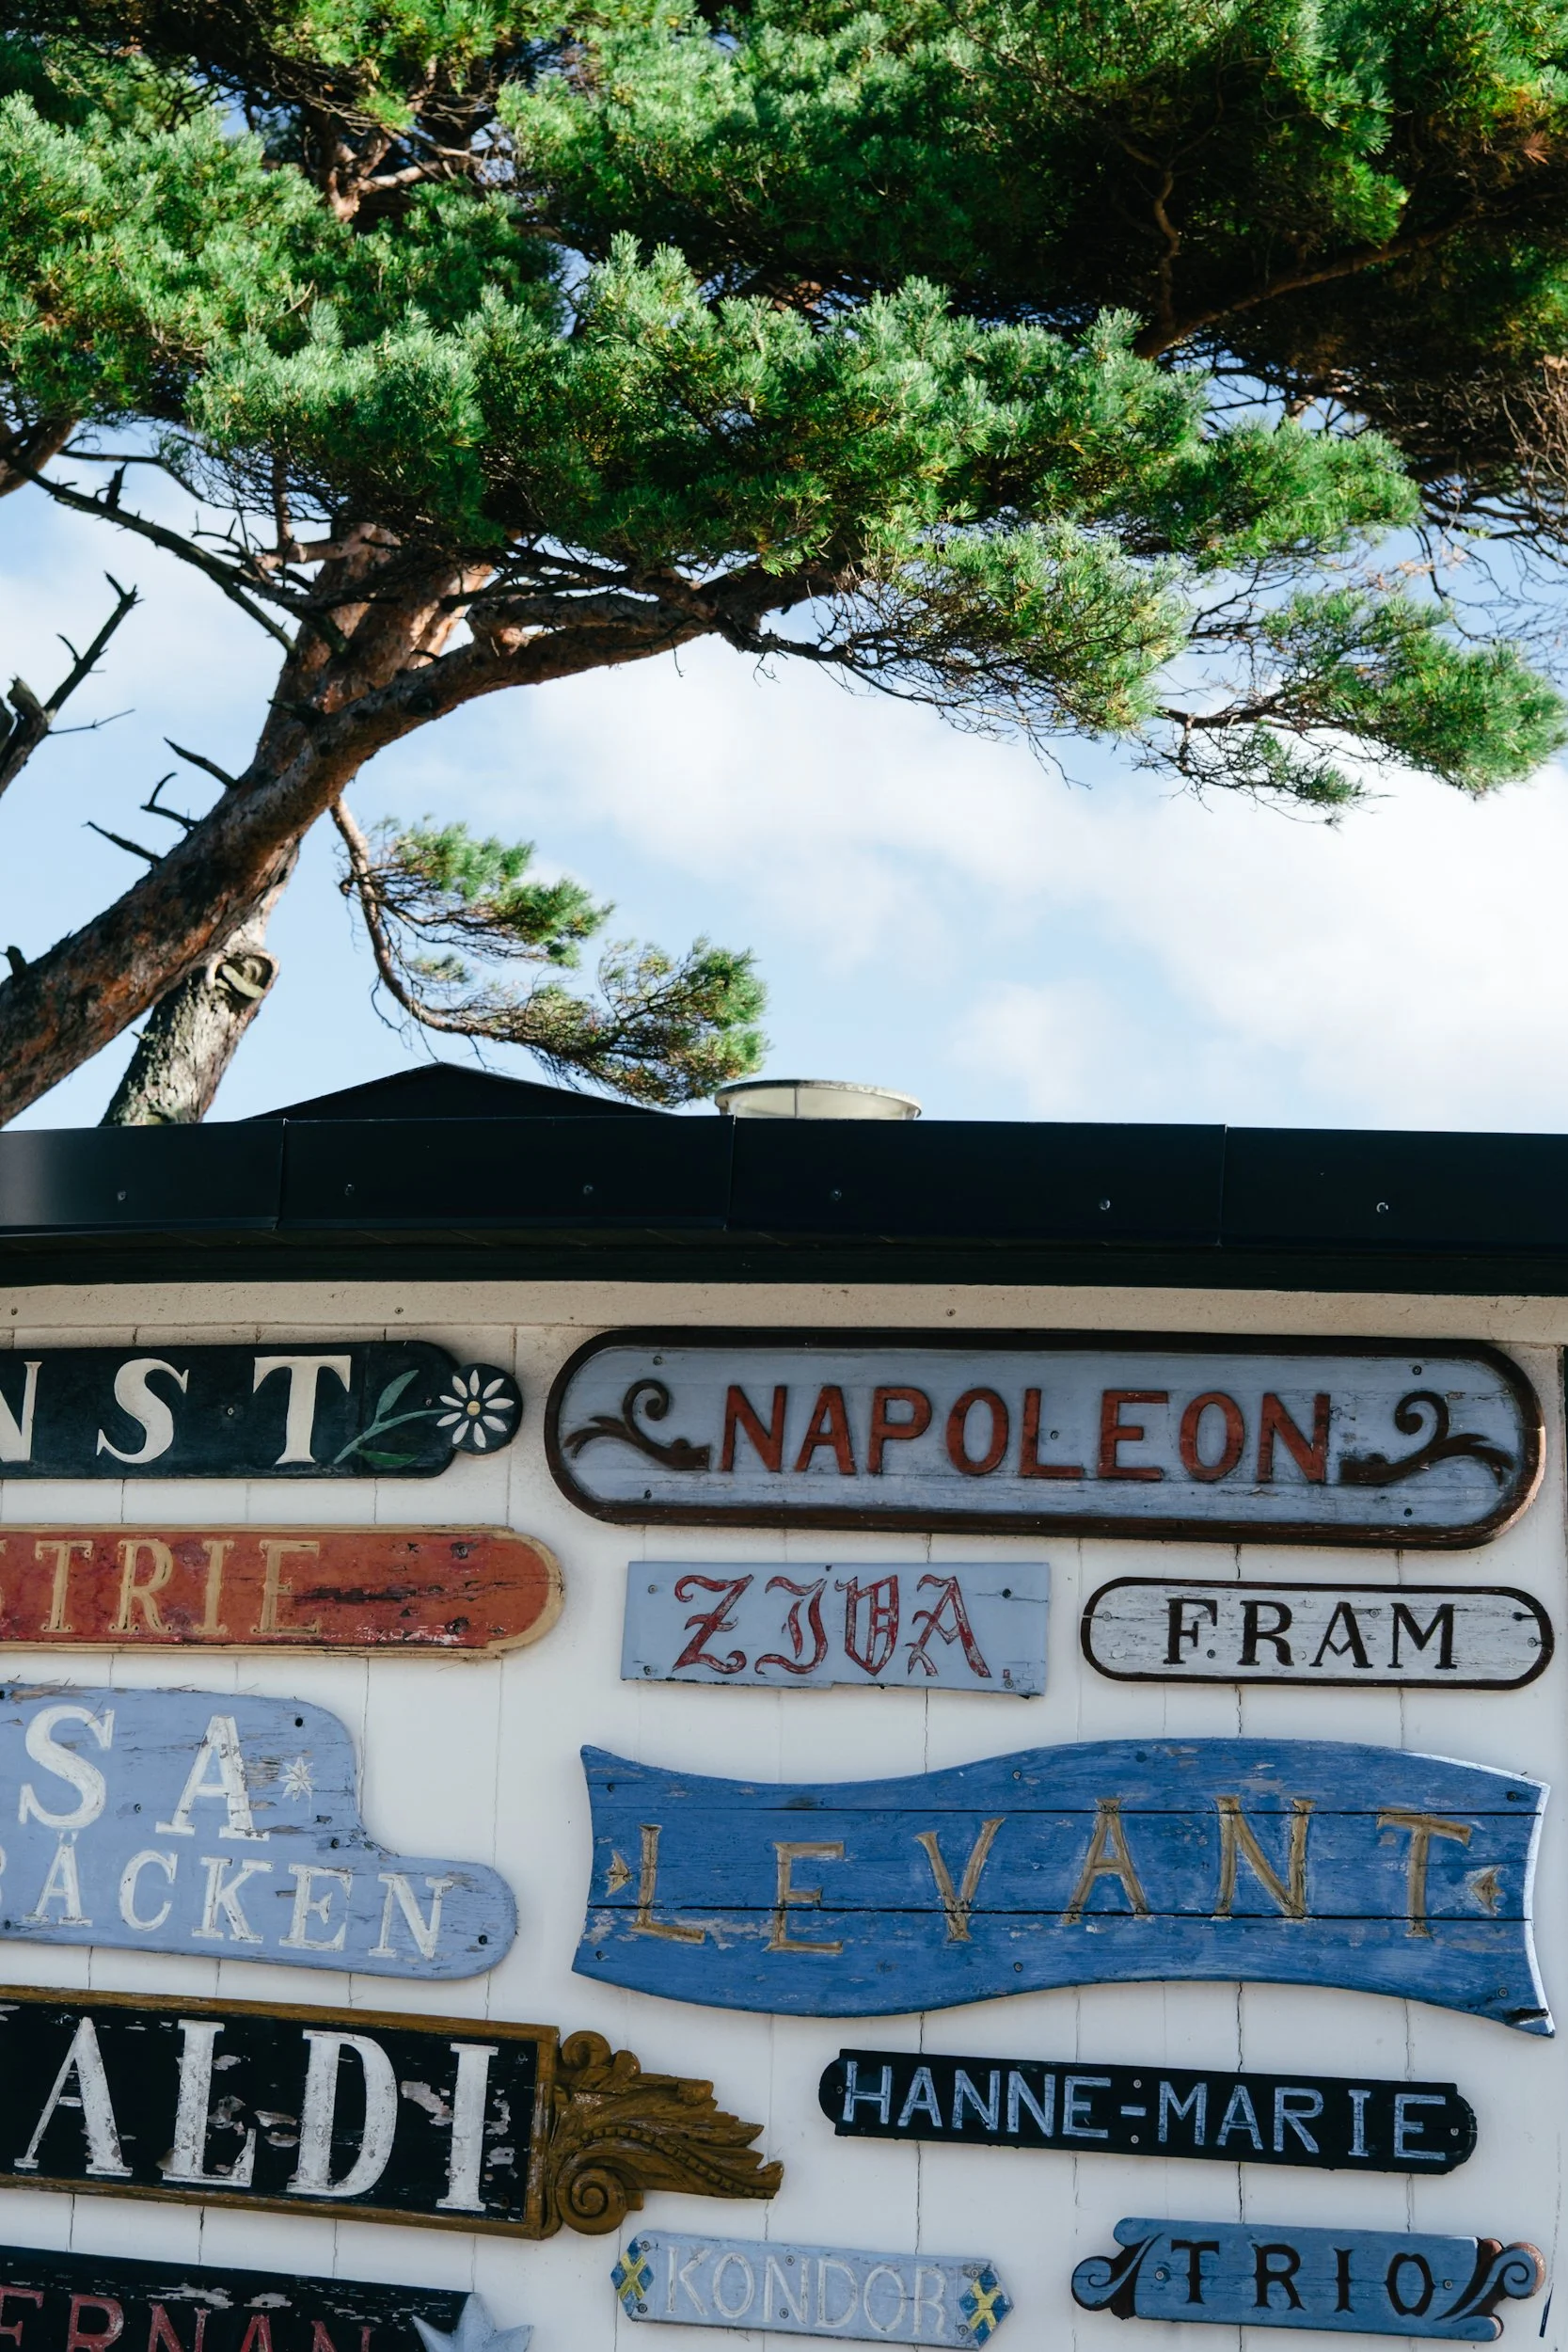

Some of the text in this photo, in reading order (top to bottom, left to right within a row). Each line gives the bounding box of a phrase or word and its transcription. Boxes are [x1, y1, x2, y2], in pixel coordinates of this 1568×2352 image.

[720, 1384, 1327, 1484] NAPOLEON
[0, 1539, 321, 1636] TRIE
[1163, 1598, 1458, 1670] FRAM
[18, 1705, 270, 1841] SA
[0, 1831, 454, 1960] ÄCKEN
[629, 1794, 1472, 1954] LEVANT
[13, 2016, 499, 2212] ALDI
[843, 2060, 1446, 2161] HANNE-MARIE
[664, 2246, 945, 2336] KONDOR
[1171, 2238, 1436, 2317] TRIO
